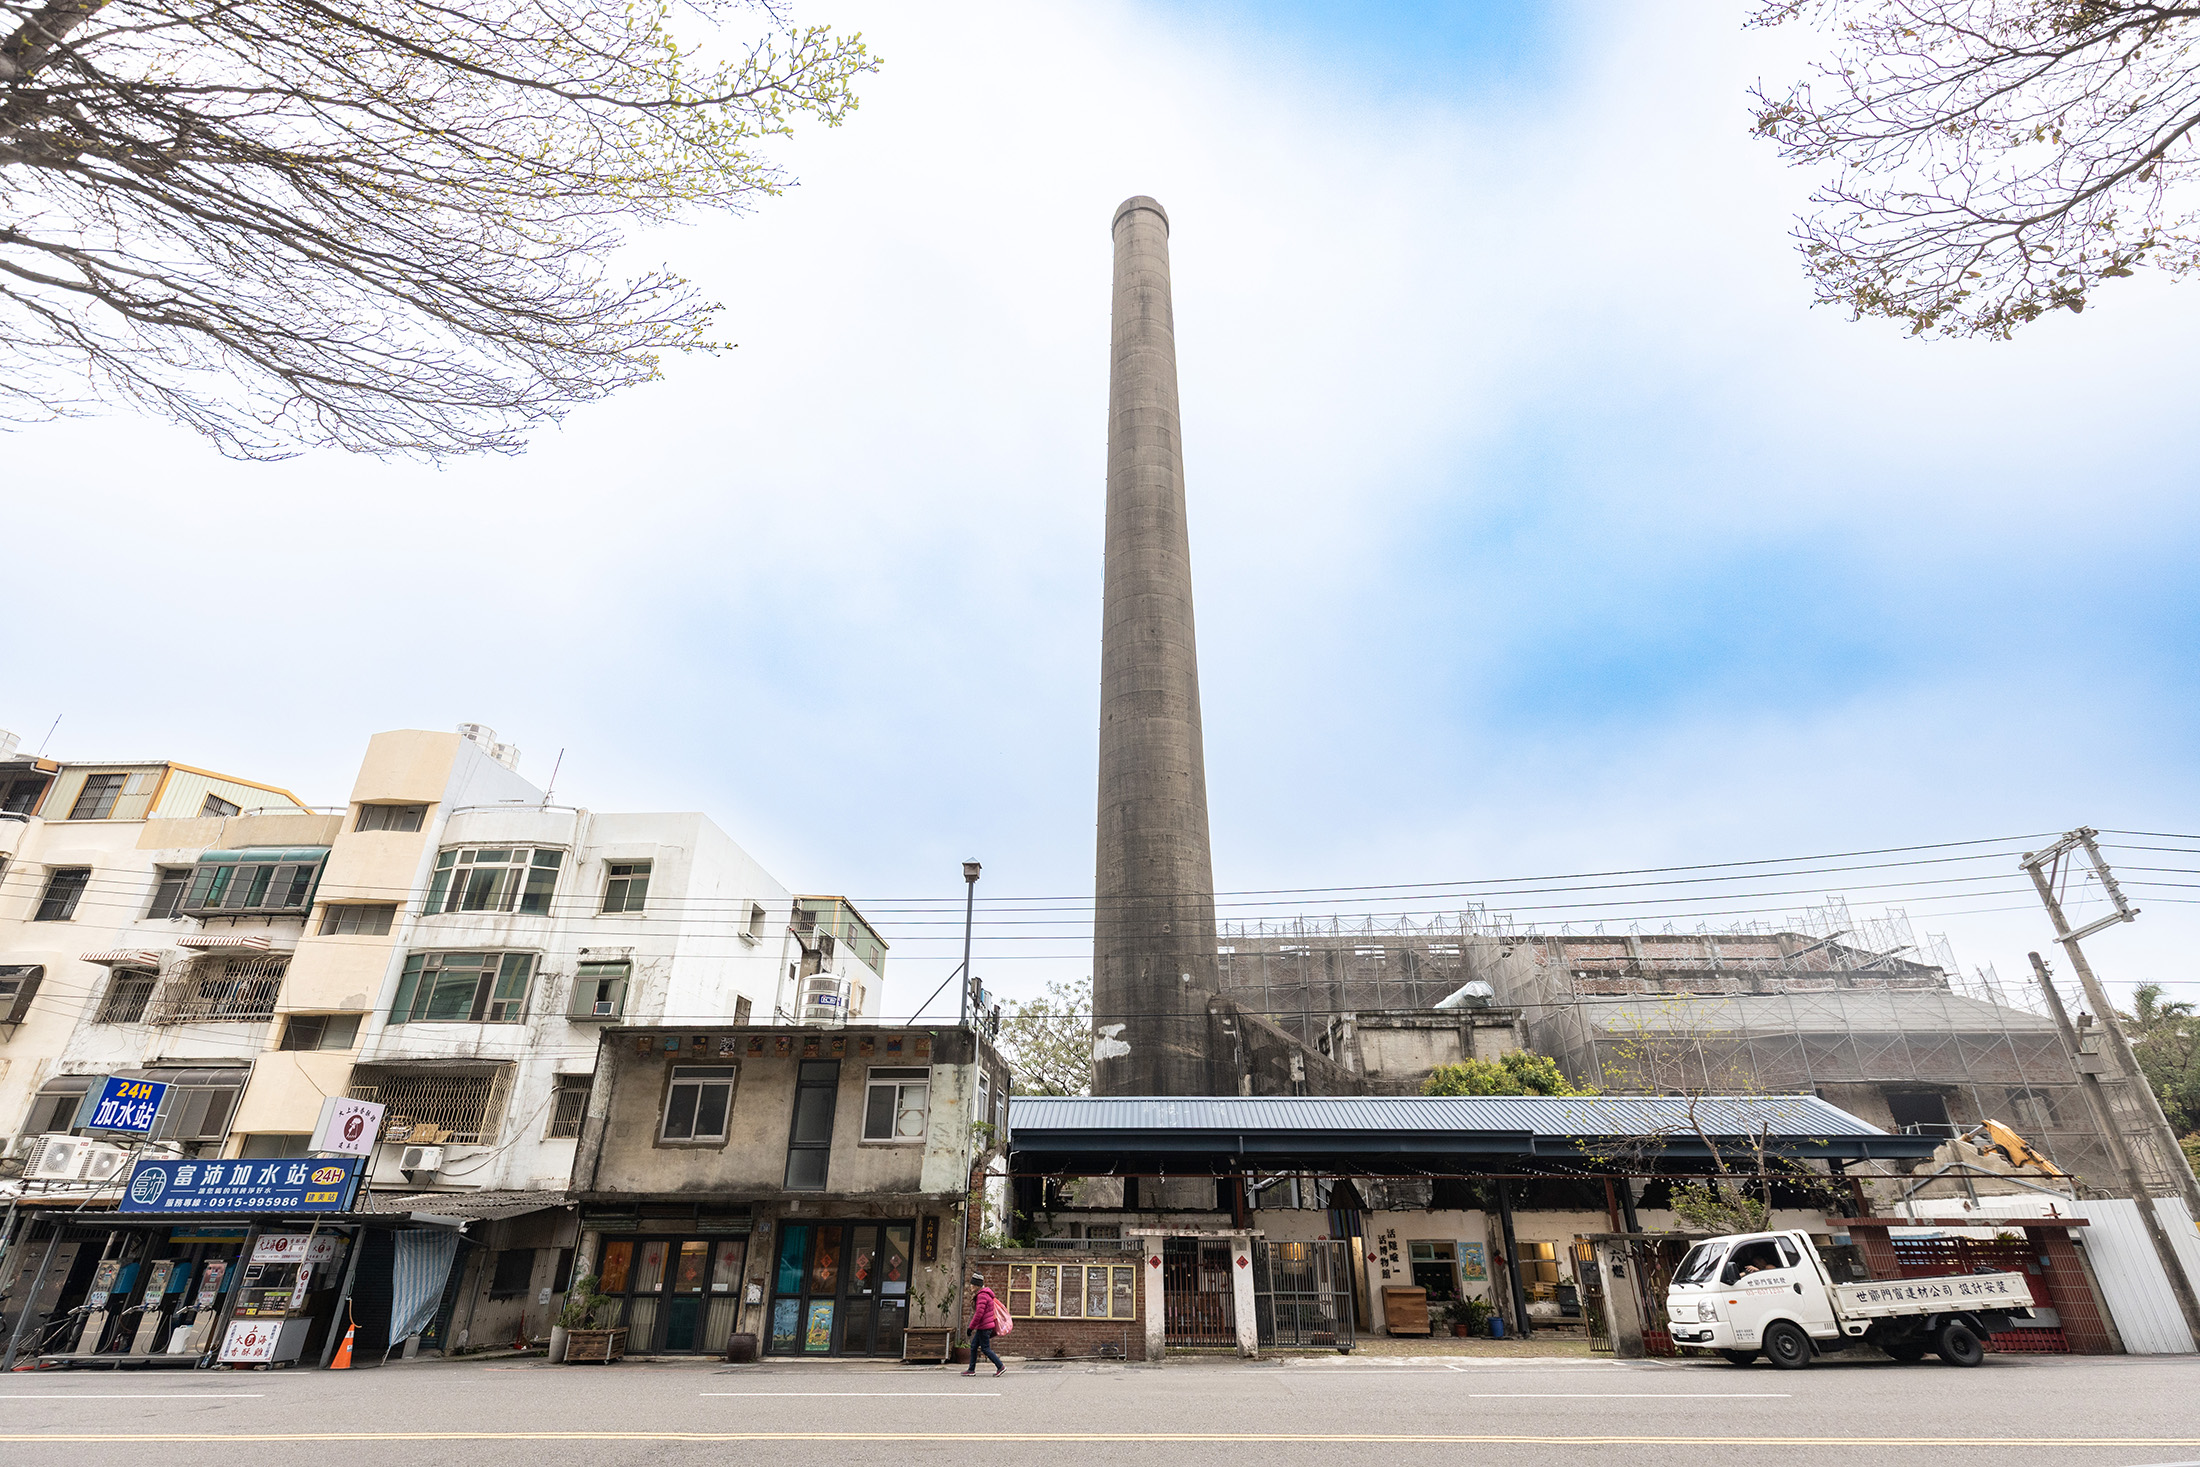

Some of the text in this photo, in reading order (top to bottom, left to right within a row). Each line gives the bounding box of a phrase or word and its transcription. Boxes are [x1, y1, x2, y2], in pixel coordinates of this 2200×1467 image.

[116, 1082, 154, 1100] 24H
[93, 1097, 155, 1129] 加水站
[173, 1163, 310, 1186] 富沛加水站
[313, 1168, 344, 1182] 24H
[307, 1193, 336, 1201] 建美站
[1378, 1234, 1391, 1279] 活博物館
[1959, 1280, 2009, 1296] 設計安裝
